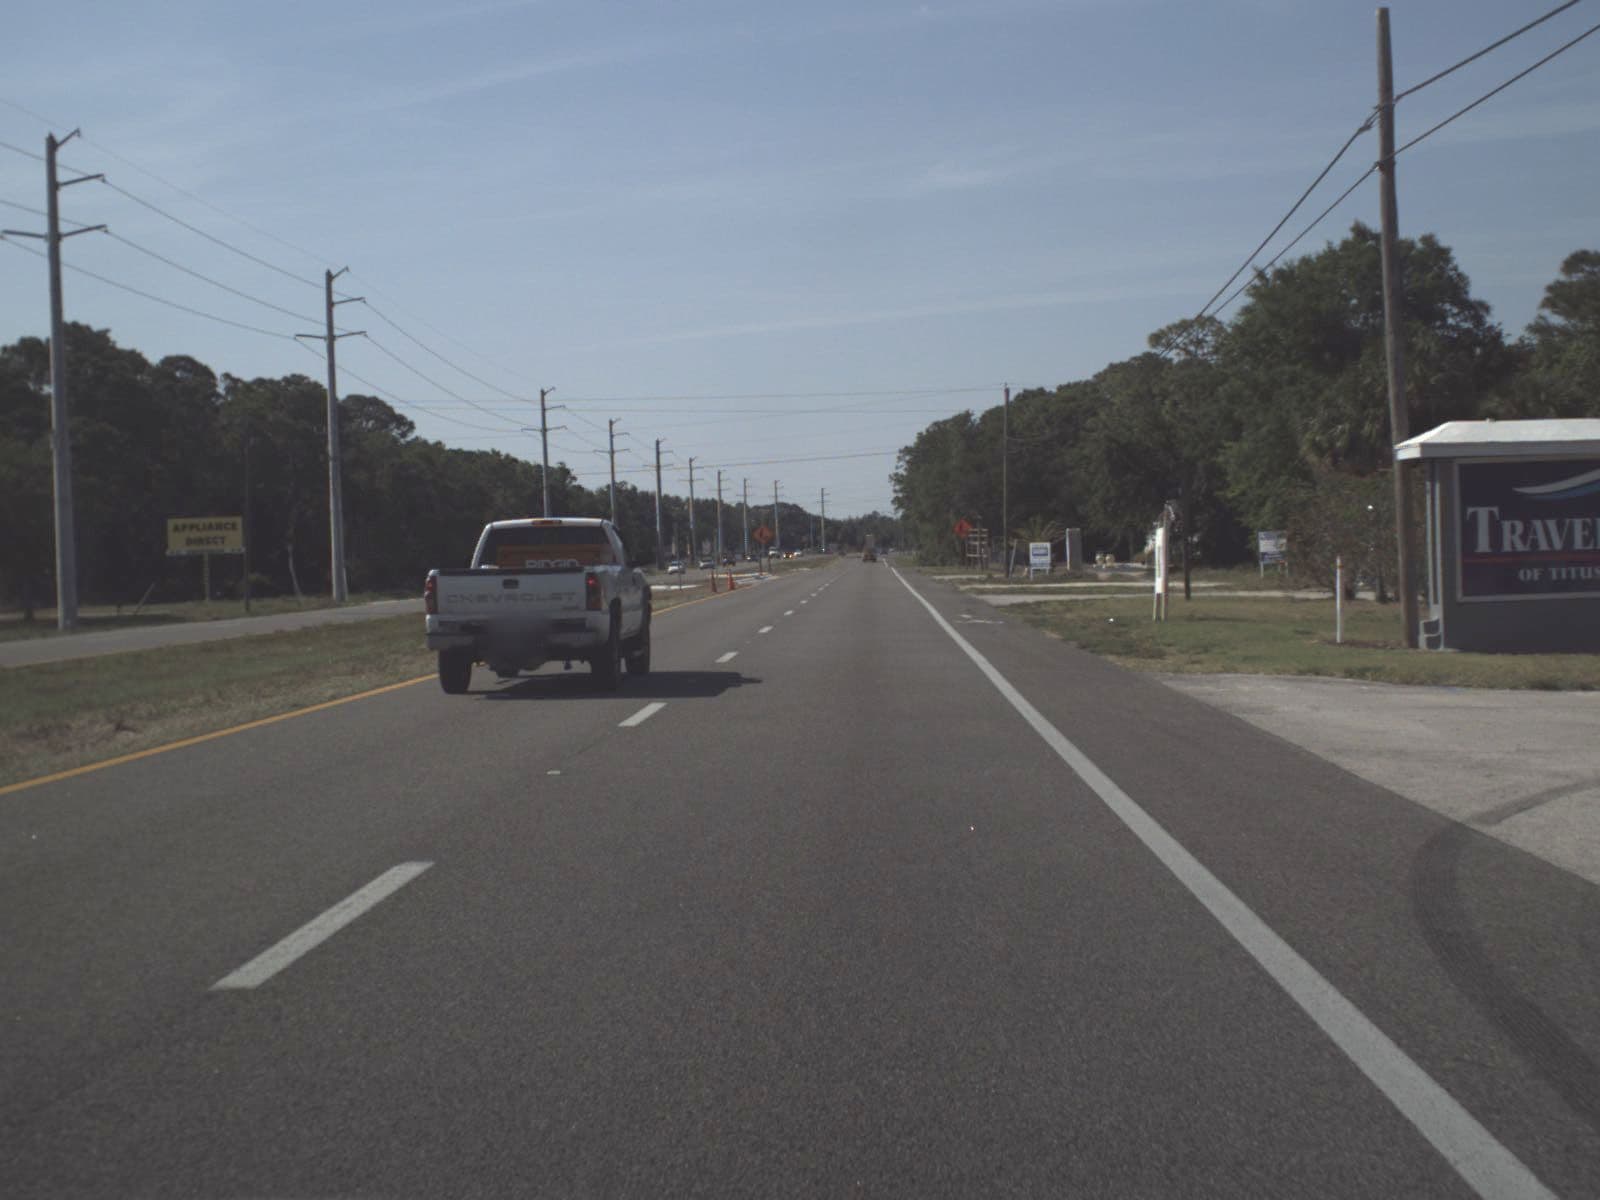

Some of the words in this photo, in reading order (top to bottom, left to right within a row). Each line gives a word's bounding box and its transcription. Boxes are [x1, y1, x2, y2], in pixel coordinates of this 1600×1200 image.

[172, 520, 238, 533] APPLIANCE
[184, 535, 225, 546] DIRECT
[1518, 568, 1544, 582] OF
[446, 592, 576, 604] CHEVROLET
